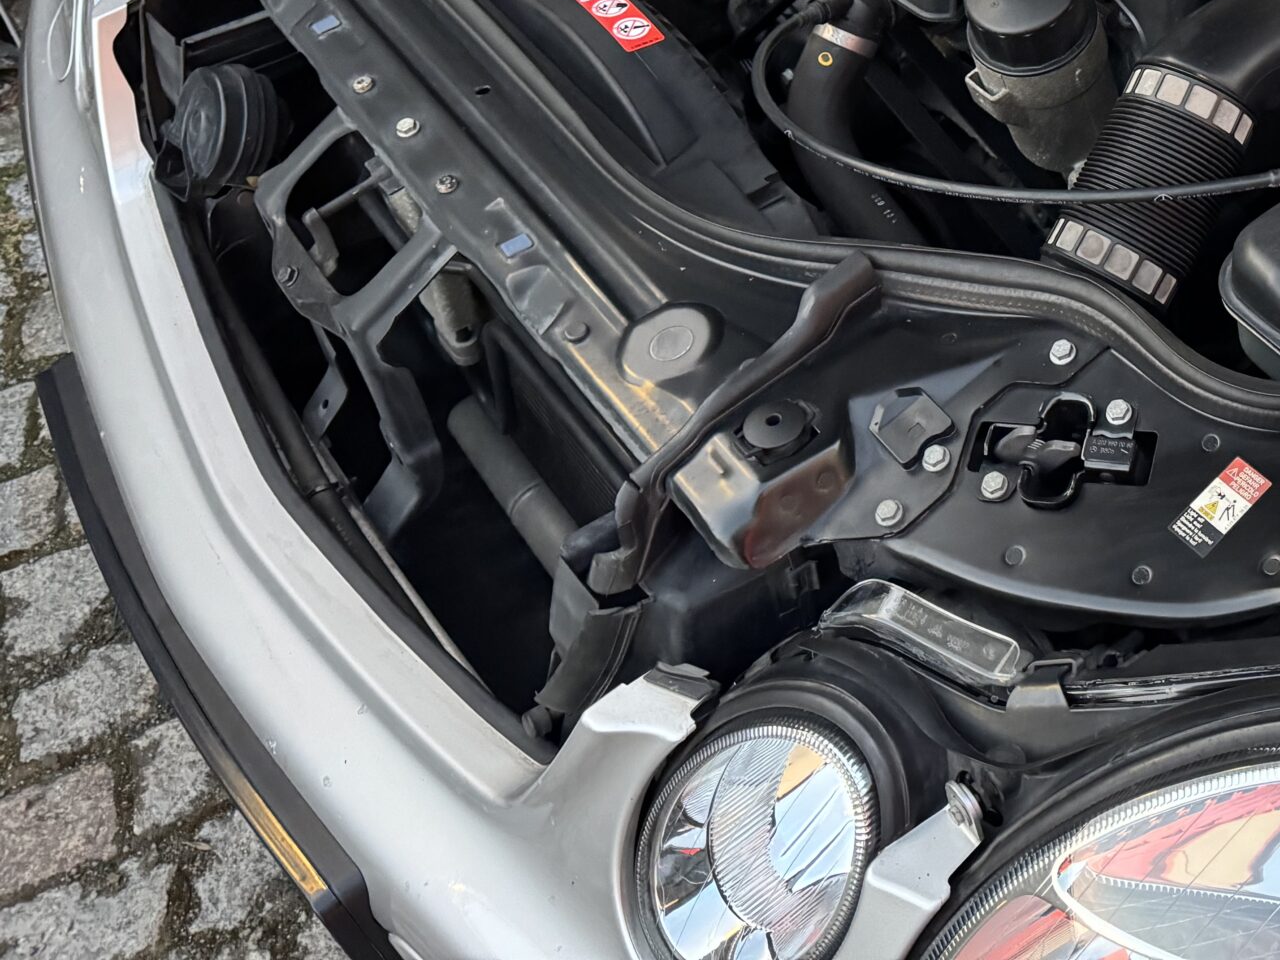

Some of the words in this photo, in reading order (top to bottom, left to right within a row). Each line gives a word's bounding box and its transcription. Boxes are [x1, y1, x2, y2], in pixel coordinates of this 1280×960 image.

[1239, 471, 1260, 490] GEFAHR
[1243, 466, 1265, 486] DANGER
[1229, 481, 1252, 500] PELIGRO
[1234, 476, 1259, 498] PERICOLO
